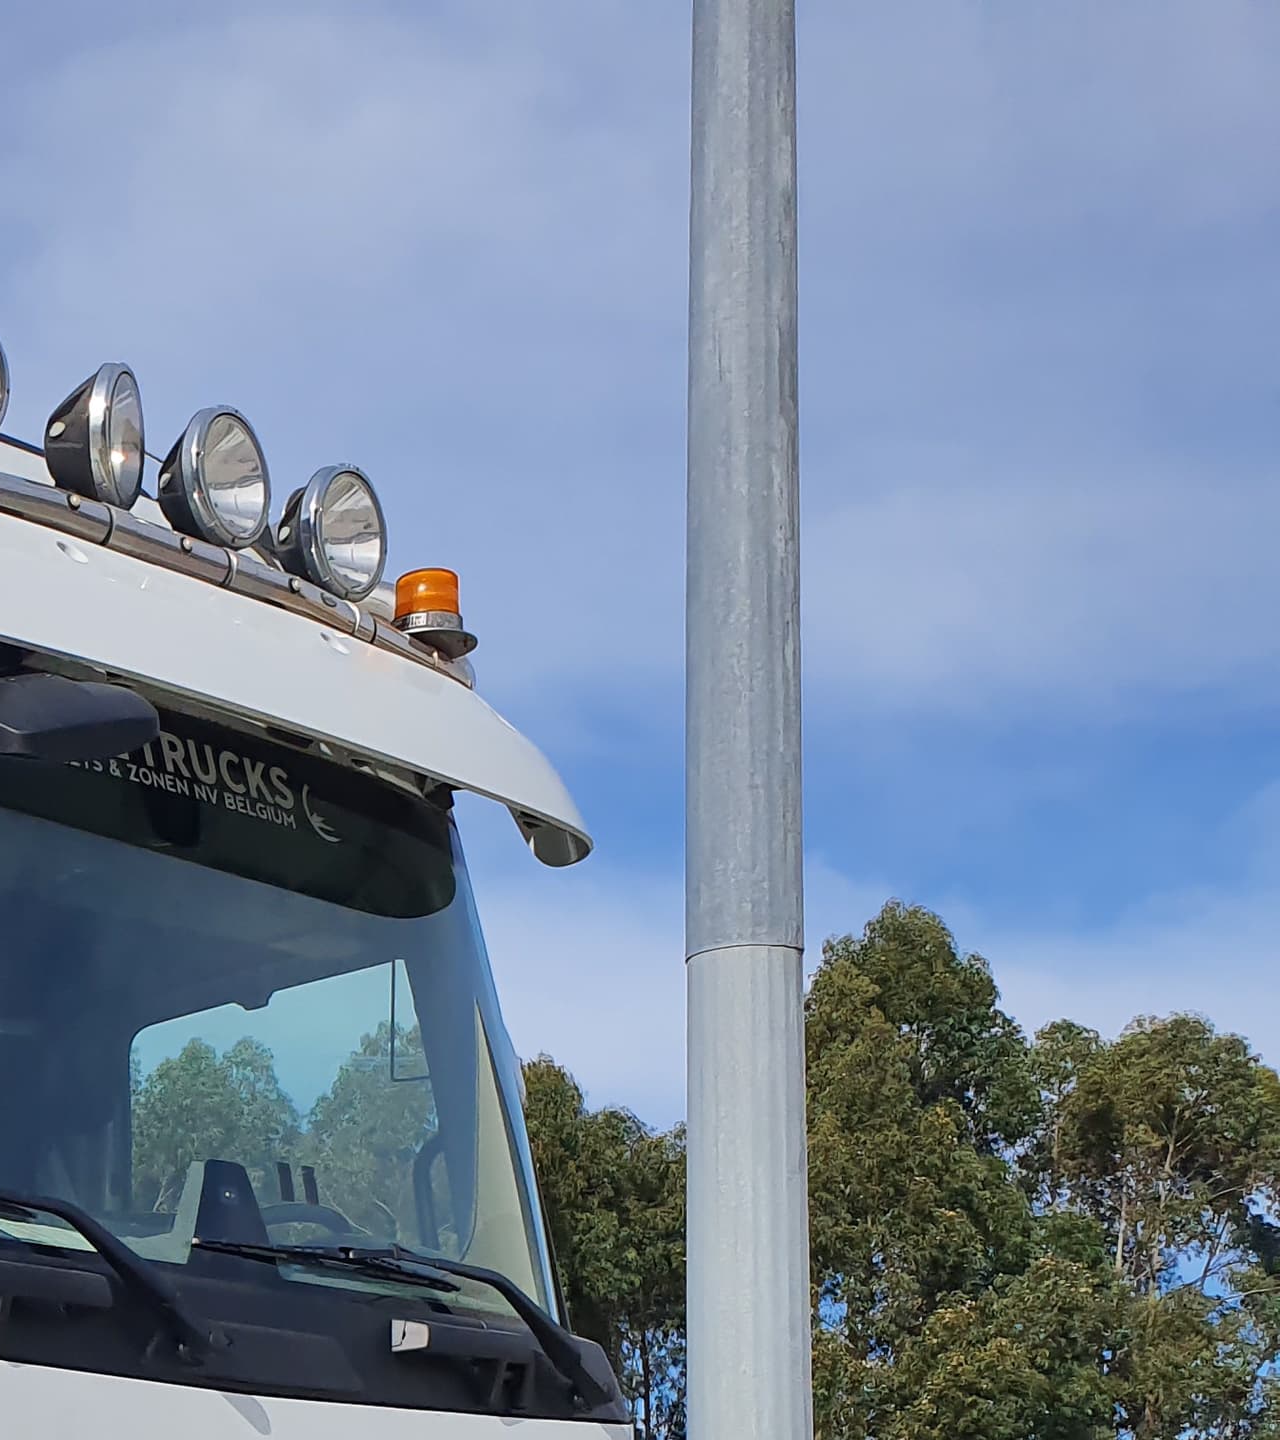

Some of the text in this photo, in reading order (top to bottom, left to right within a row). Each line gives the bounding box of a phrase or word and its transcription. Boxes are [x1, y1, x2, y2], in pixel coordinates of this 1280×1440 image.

[126, 763, 190, 796] ZONEN
[193, 783, 218, 805] NV
[223, 792, 297, 829] BELGIUM
